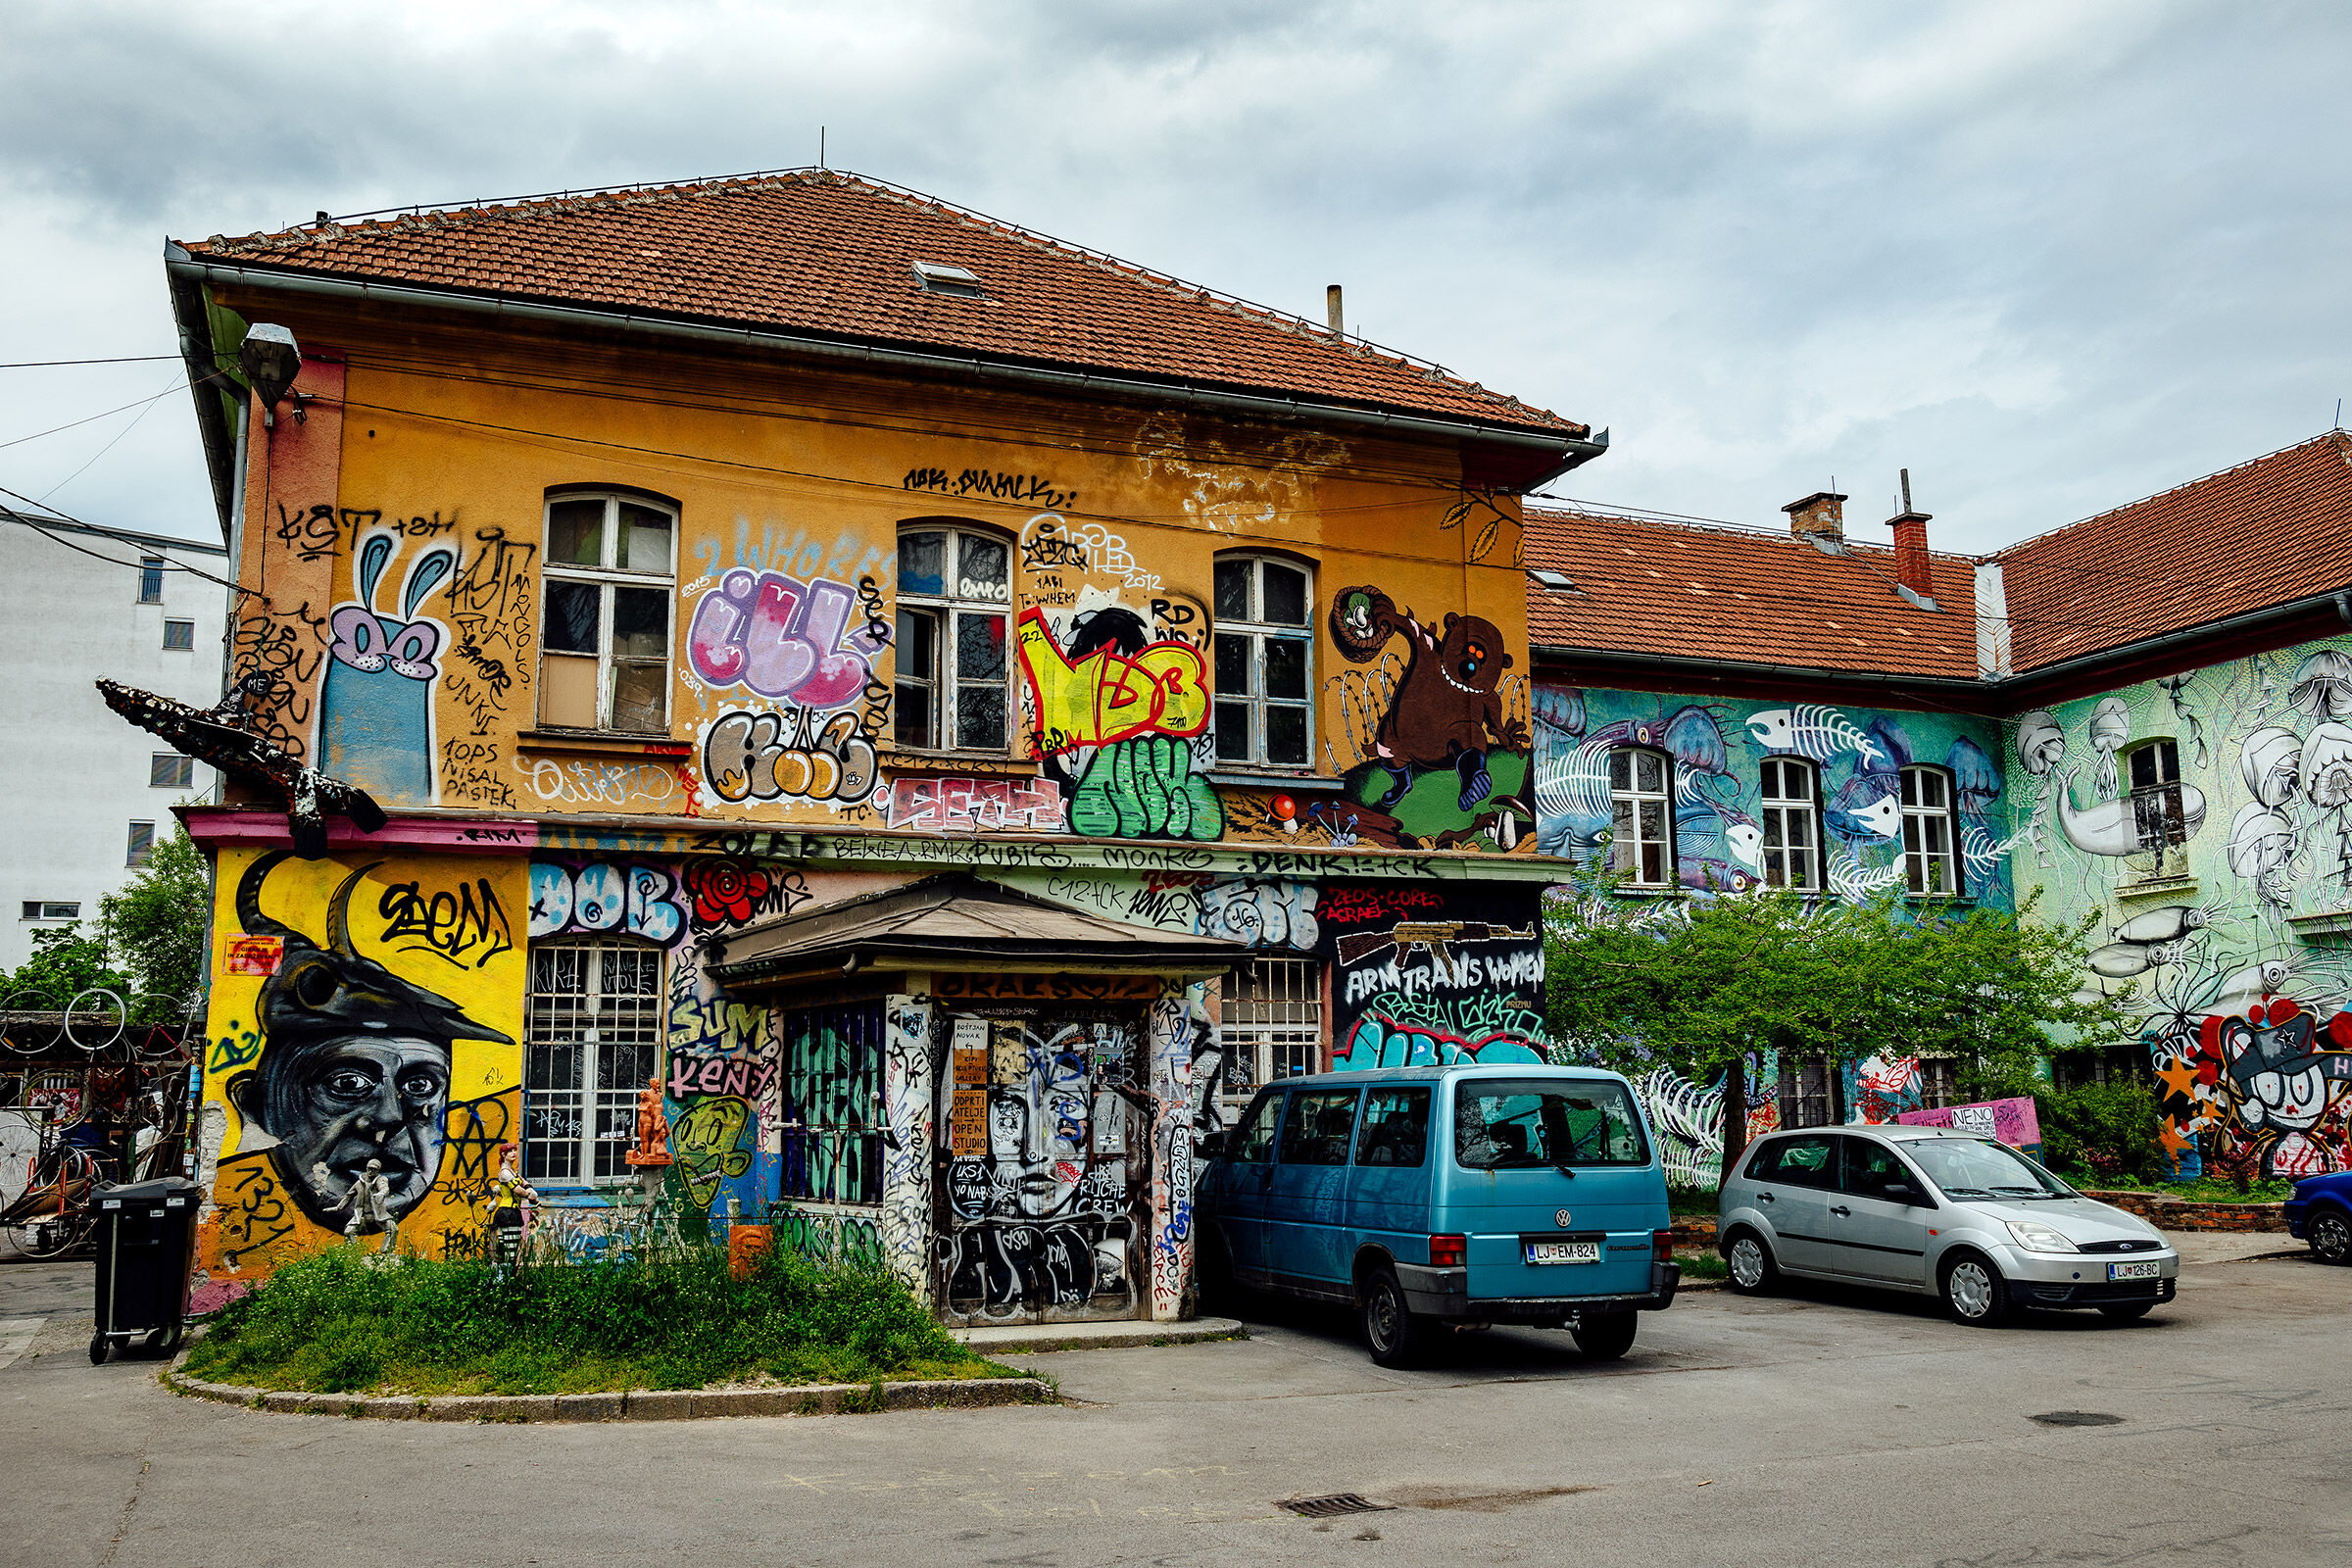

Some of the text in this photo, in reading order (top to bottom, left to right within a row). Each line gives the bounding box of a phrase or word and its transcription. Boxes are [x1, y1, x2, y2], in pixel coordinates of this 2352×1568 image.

[681, 575, 711, 598] 2015
[1124, 573, 1165, 591] 2012
[1020, 630, 1044, 644] 22
[248, 678, 267, 692] ME
[1346, 946, 1545, 1005] ARM TRANS WOMEN
[954, 1096, 985, 1106] ODPRTI
[954, 1107, 985, 1118] ATELJE
[954, 1124, 982, 1134] OPEN
[954, 1137, 986, 1149] STUDIO
[1075, 1198, 1134, 1215] CREW
[1536, 1244, 1596, 1259] LJ EM-824
[2117, 1263, 2158, 1278] LJ 126-BC
